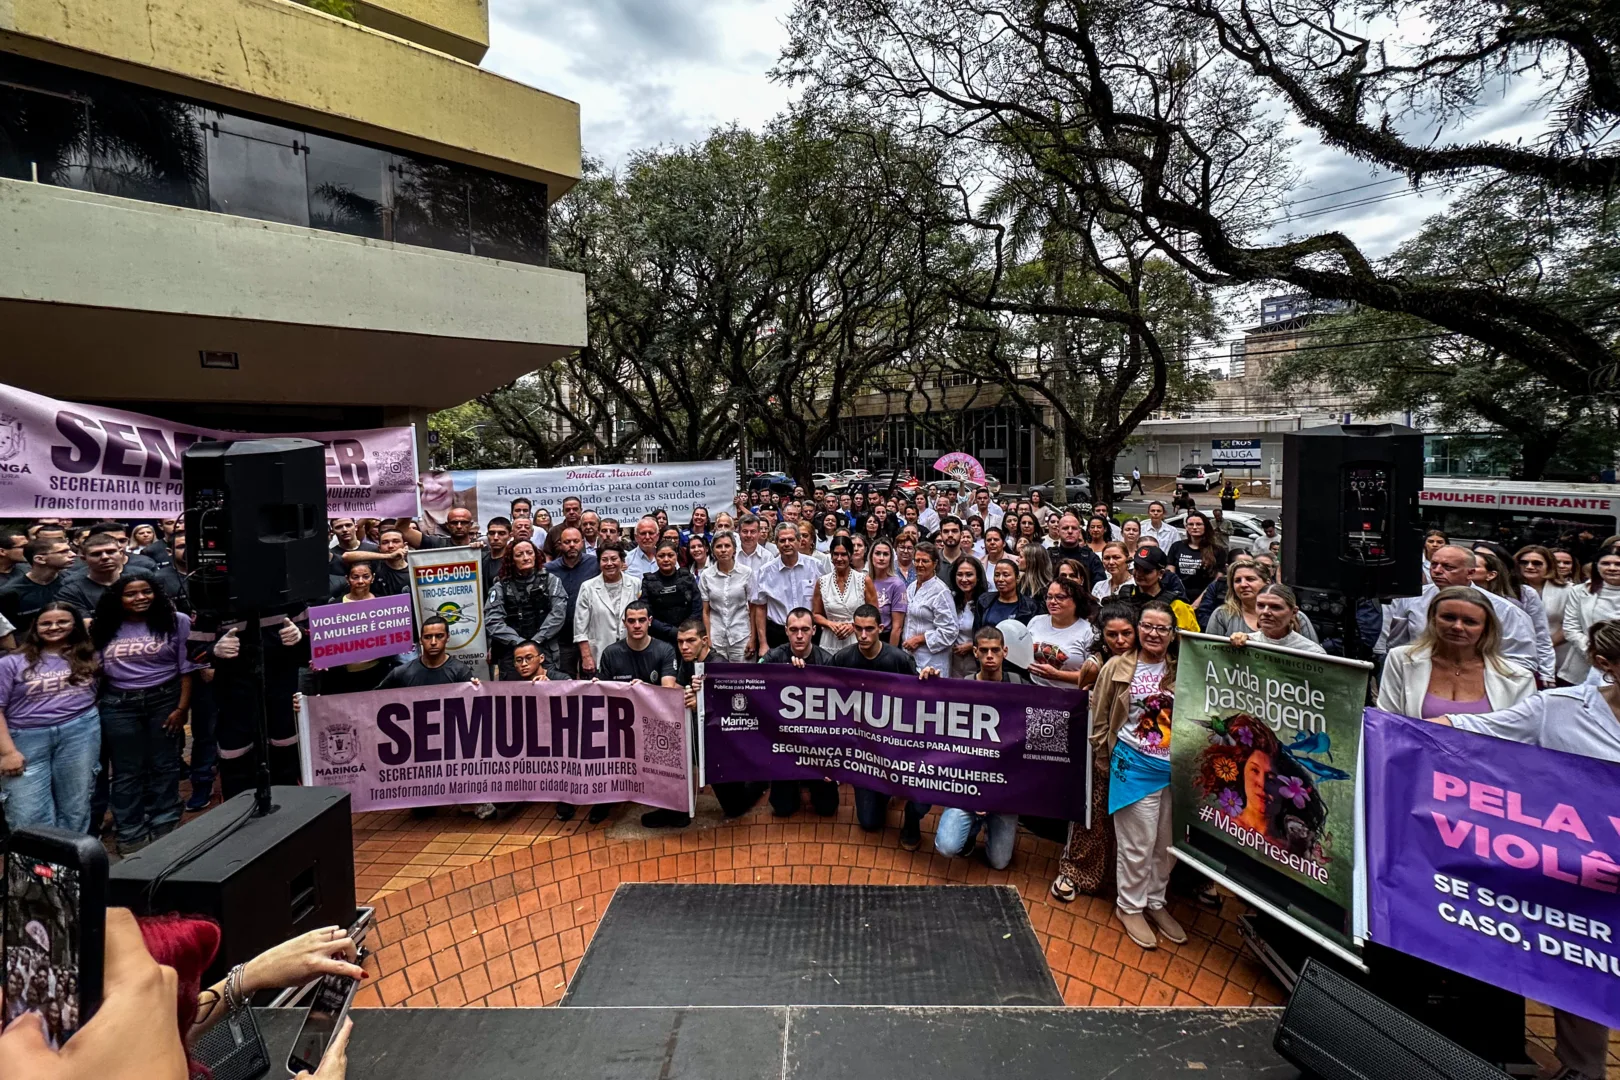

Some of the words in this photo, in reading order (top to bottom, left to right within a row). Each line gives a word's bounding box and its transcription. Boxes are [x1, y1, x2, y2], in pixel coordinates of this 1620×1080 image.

[1219, 450, 1253, 458] ALUGA
[50, 476, 140, 494] SECRETARIA
[145, 481, 161, 495] DE
[566, 469, 605, 479] Daniela
[497, 486, 532, 495] Ficam
[551, 482, 605, 493] memórias
[608, 483, 633, 492] para
[635, 480, 670, 489] contar
[703, 477, 716, 486] foi
[615, 494, 641, 502] resta
[658, 490, 706, 500] saudades
[34, 494, 144, 511] Transformando
[150, 499, 184, 511] Marin
[327, 502, 340, 512] ser
[344, 501, 377, 511] Mulher!
[595, 506, 618, 515] falta
[622, 506, 642, 515] que
[1418, 491, 1496, 504] EMULHER
[1501, 494, 1611, 510] ITINERANTE
[418, 568, 435, 583] TG
[437, 565, 471, 581] 05-009
[421, 584, 473, 598] TIRO-DE-GUERRA
[312, 613, 367, 628] VIOLÊNCIA
[369, 605, 409, 619] CONTRA
[313, 632, 322, 641] A
[324, 624, 368, 639] MULHER
[371, 619, 376, 632] É
[378, 617, 411, 631] CRIME
[314, 637, 387, 659] DENUNCIE
[390, 631, 411, 645] 153
[1205, 660, 1220, 684] A
[1223, 663, 1260, 693] vida
[1266, 678, 1325, 710] pede
[779, 685, 1001, 743] SEMULHER
[1204, 684, 1327, 735] passagem
[377, 695, 636, 766] SEMULHER
[721, 716, 759, 727] Maringá
[778, 725, 828, 735] SECRETARIA
[829, 727, 841, 735] DE
[842, 727, 882, 743] POLÍTICAS
[883, 735, 925, 749] PÚBLICAS
[926, 741, 950, 752] PARA
[952, 744, 1000, 758] MULHERES
[315, 763, 366, 776] MARINGÁ
[772, 743, 843, 759] SEGURANÇA
[845, 748, 852, 757] E
[854, 749, 916, 772] DIGNIDADE
[918, 760, 935, 775] ÀS
[937, 764, 1008, 784] MULHERES.
[1023, 753, 1071, 763] @SEMULHERMARINGA
[379, 765, 442, 783] SECRETARIA
[446, 763, 459, 777] DE
[461, 758, 510, 776] POLÍTICAS
[512, 758, 559, 775] PÚBLICAS
[561, 761, 581, 777] PARA
[584, 761, 637, 777] MULHERES
[795, 756, 840, 768] JUNTAS
[843, 760, 888, 779] CONTRA
[890, 773, 899, 783] O
[901, 775, 981, 796] FEMINICÍDIO.
[370, 783, 445, 801] Transformando
[449, 779, 487, 795] Maringá
[491, 781, 502, 792] na
[505, 779, 536, 792] melhor
[540, 779, 569, 793] cidade
[570, 783, 588, 795] para
[592, 782, 607, 794] ser
[611, 779, 645, 794] Mulher!
[1433, 770, 1594, 843] PELA
[1198, 804, 1329, 886] #MagóPresente
[1431, 811, 1620, 894] VIOLÊ
[1433, 873, 1470, 900] SE
[1477, 886, 1612, 944] SOUBER
[1438, 902, 1531, 951] CASO,
[1538, 932, 1620, 978] DENU
